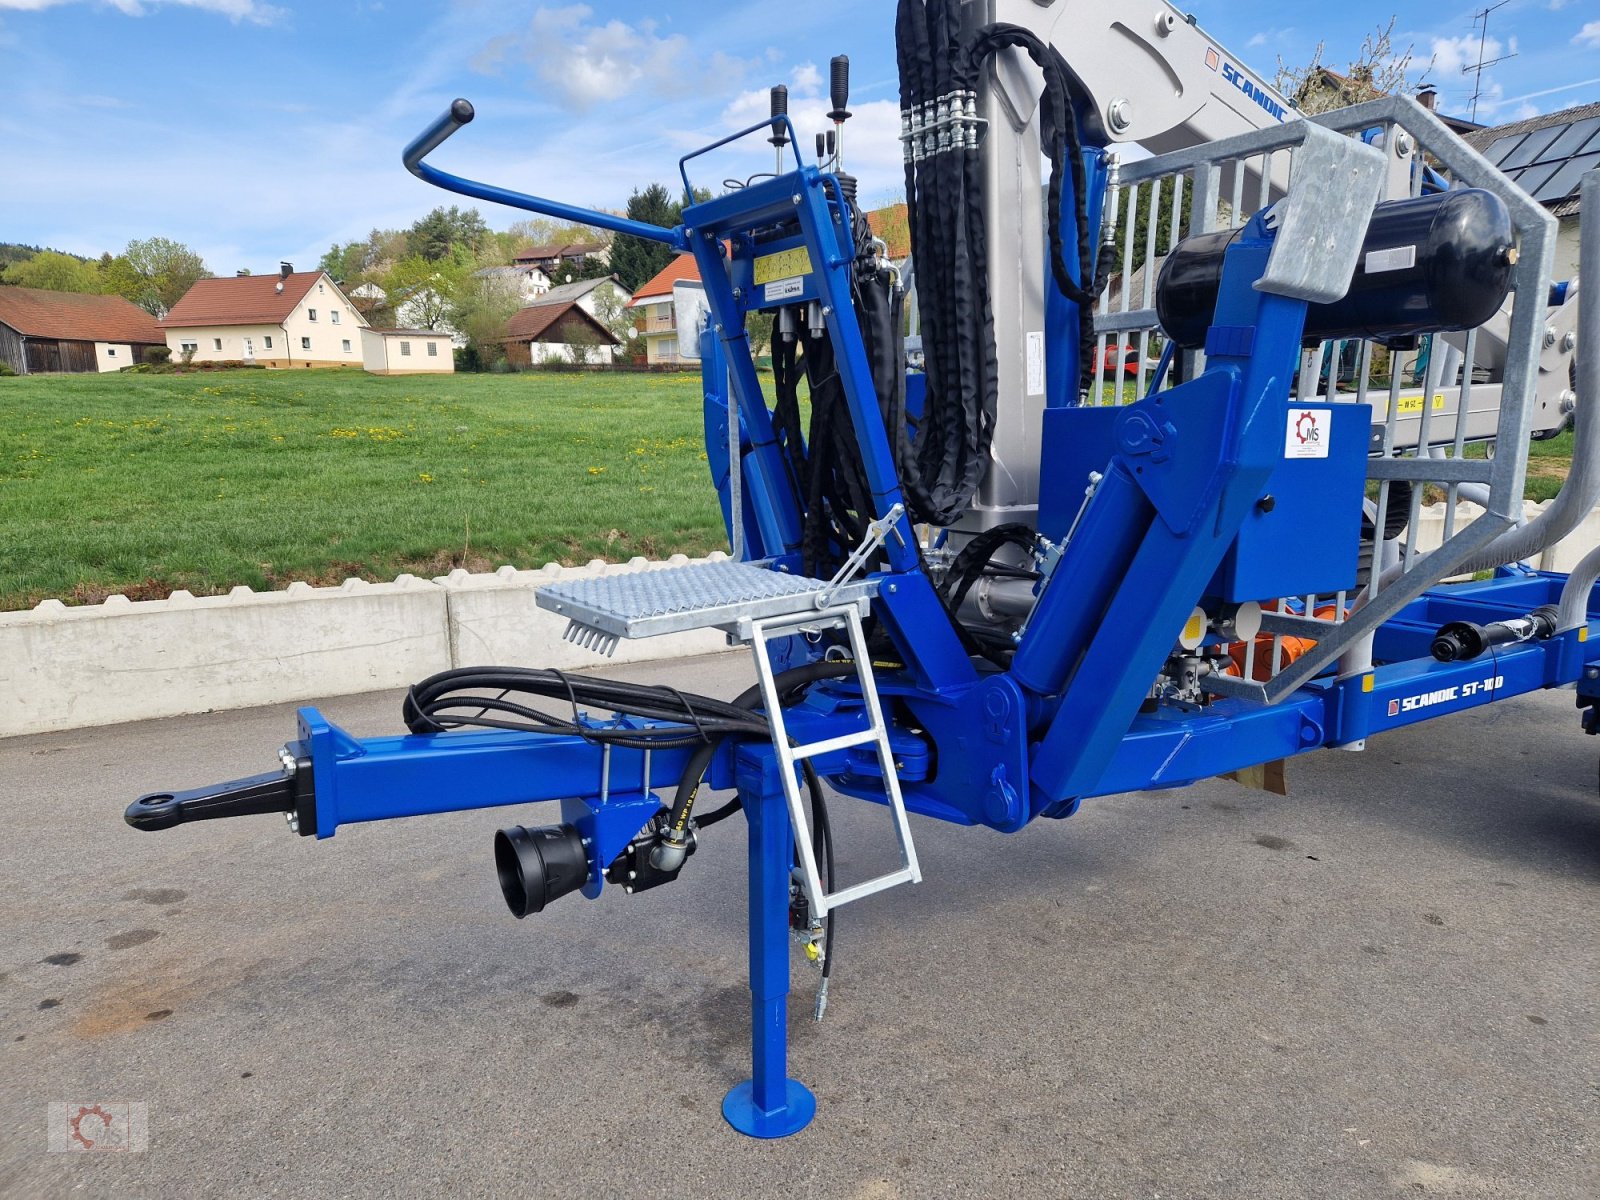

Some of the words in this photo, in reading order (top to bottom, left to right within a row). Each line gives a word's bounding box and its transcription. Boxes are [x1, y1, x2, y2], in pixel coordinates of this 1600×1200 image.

[1222, 62, 1288, 124] SCANDIC
[1306, 427, 1319, 442] MS
[1402, 686, 1459, 712] SCANDIC
[686, 799, 693, 807] 10
